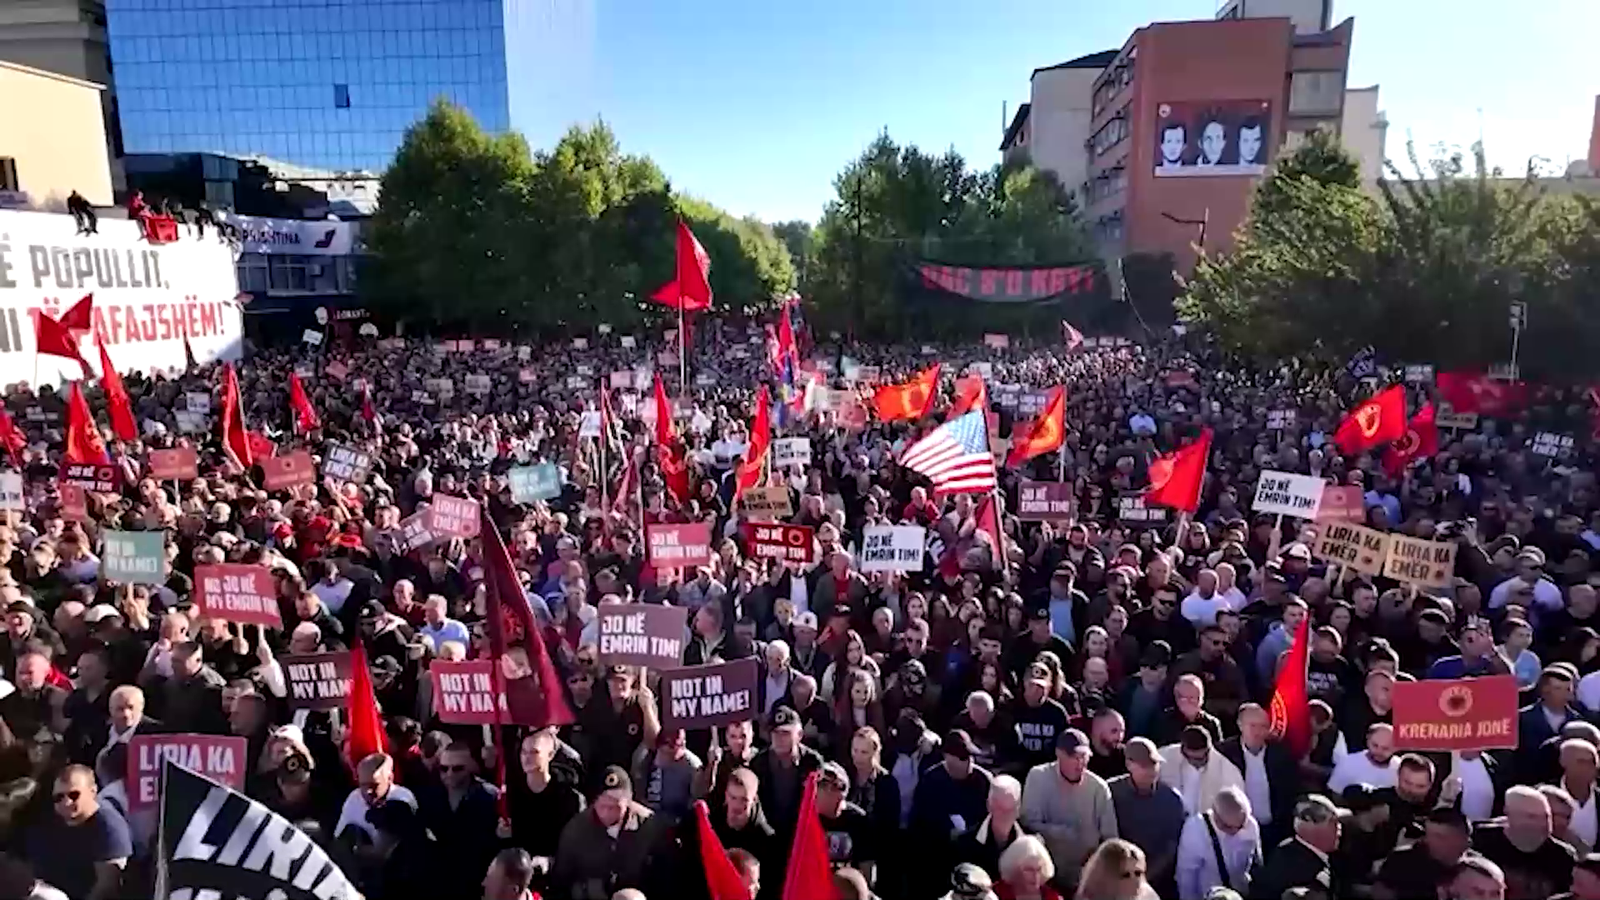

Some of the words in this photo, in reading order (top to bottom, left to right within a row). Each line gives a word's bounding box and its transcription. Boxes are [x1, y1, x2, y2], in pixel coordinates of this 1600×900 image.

[29, 245, 169, 290] POPULLIT,
[68, 294, 224, 347] AFAJSHËM!
[1325, 525, 1361, 546] LIRIA
[1363, 534, 1382, 552] KA
[1393, 540, 1431, 562] LIRIA
[1433, 548, 1451, 564] KA
[602, 614, 624, 634] JO
[625, 611, 646, 634] NË
[600, 635, 649, 655] EMRIN
[650, 636, 680, 659] TIM!
[287, 663, 317, 682] NOT
[318, 662, 336, 680] IN
[440, 673, 470, 692] NOT
[472, 673, 491, 692] IN
[290, 681, 316, 699] MY
[317, 679, 353, 698] NAM
[670, 678, 705, 700] NOT
[705, 674, 724, 696] IN
[443, 693, 467, 713] MY
[671, 697, 699, 718] MY
[700, 689, 750, 717] NAME!
[1399, 722, 1473, 740] KRENARIA
[207, 744, 236, 774] KA
